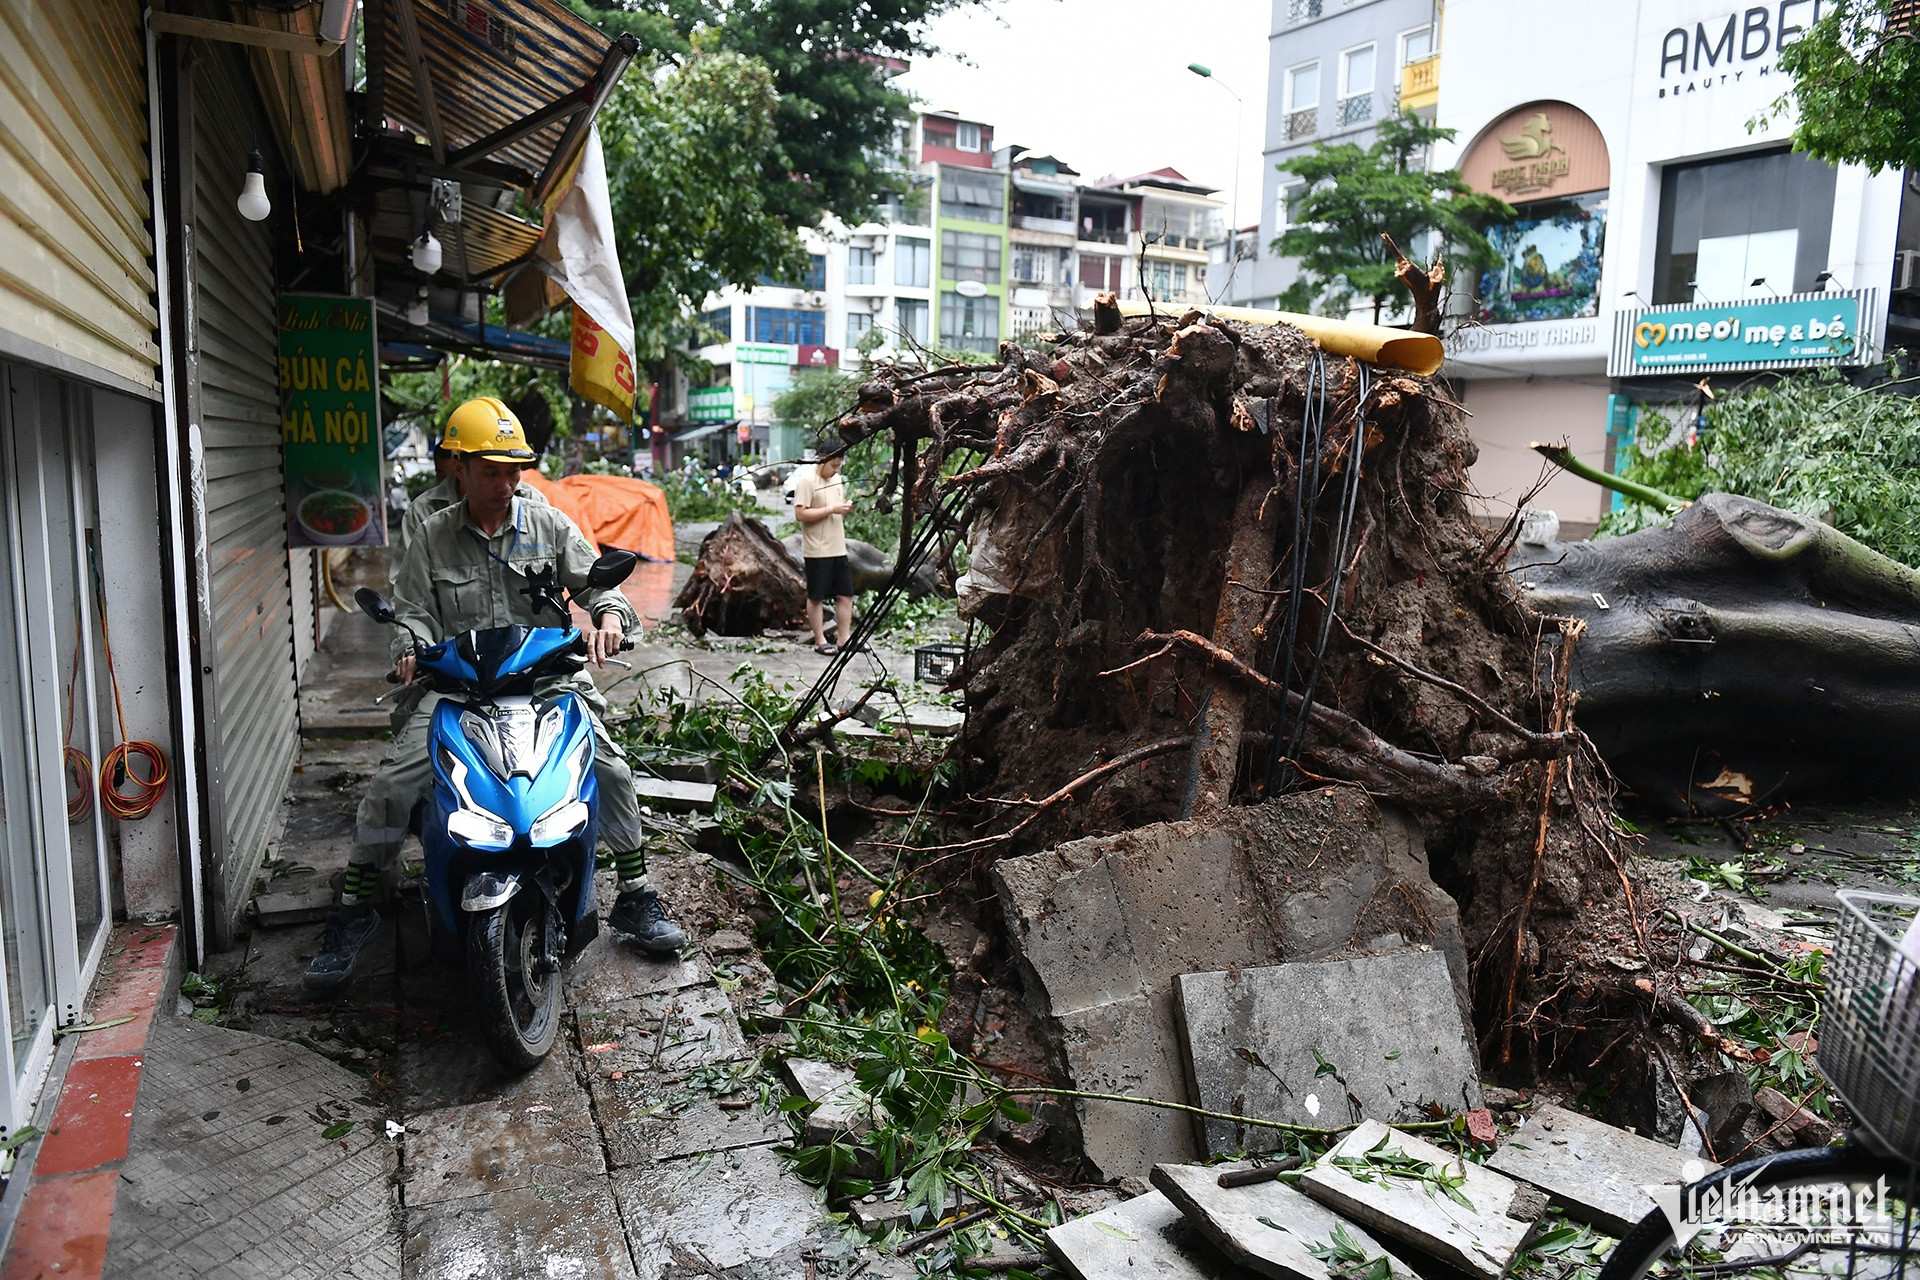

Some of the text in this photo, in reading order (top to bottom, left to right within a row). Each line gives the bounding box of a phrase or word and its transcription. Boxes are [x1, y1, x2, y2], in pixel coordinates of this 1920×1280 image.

[1661, 0, 1820, 78] AMBE
[1659, 71, 1743, 98] BEAUTY
[279, 307, 320, 332] Linh
[1544, 326, 1596, 346] THANH
[1744, 324, 1786, 347] mẹ
[1789, 324, 1804, 341] &
[1808, 314, 1846, 340] bé
[280, 347, 370, 392] BÚN CÁ
[284, 401, 369, 453] HÀ NỘI
